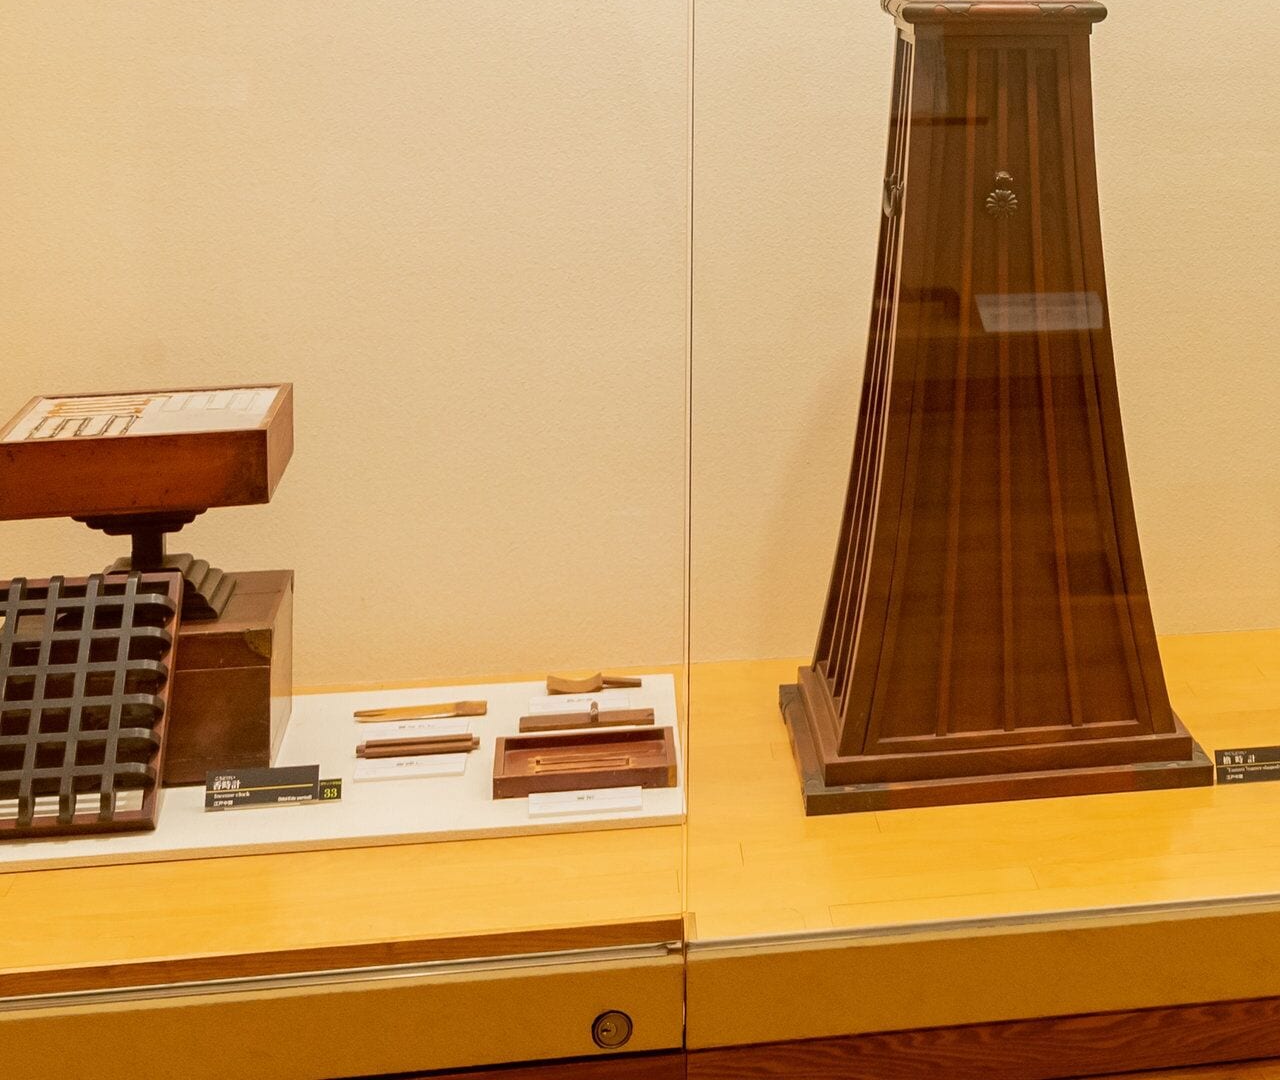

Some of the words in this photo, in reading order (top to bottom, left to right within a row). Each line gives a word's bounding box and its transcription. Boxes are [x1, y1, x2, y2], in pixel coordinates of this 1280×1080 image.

[213, 780, 240, 790] 香時計
[324, 788, 337, 798] 33
